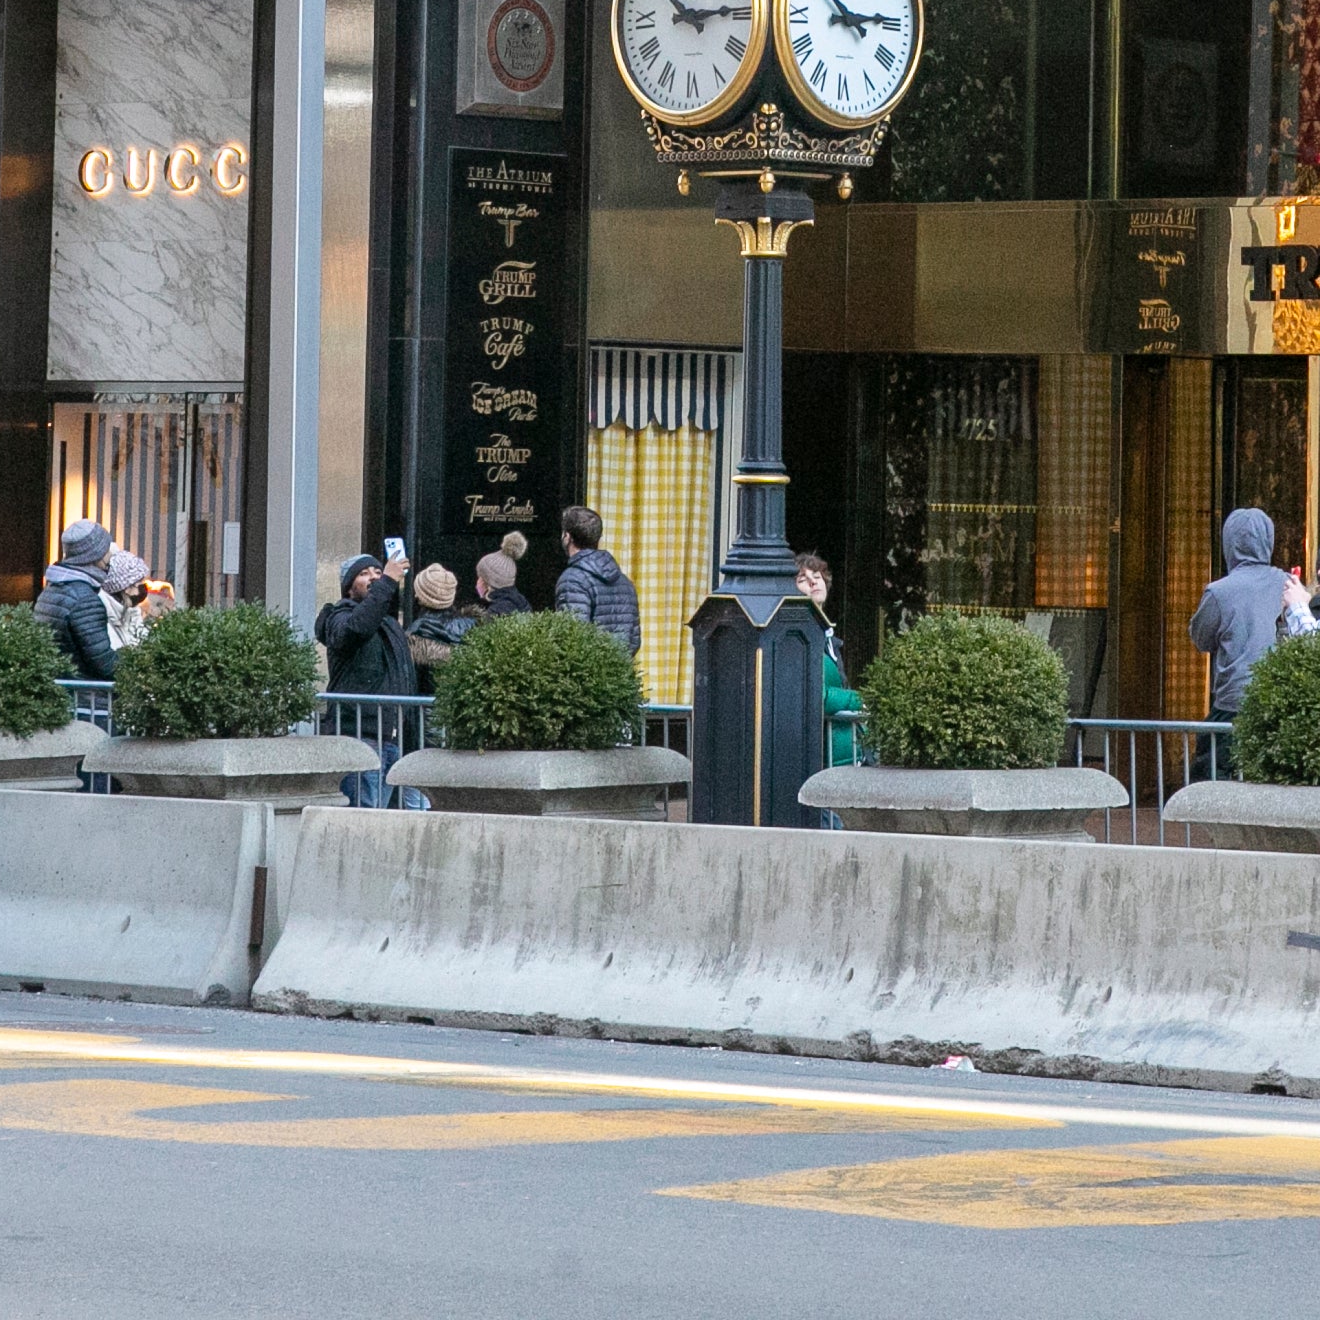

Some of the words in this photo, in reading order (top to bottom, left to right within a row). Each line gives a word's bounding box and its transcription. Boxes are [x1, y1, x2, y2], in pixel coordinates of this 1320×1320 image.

[467, 166, 493, 179] THE
[496, 160, 553, 184] ATRIUM
[478, 201, 515, 218] Trump
[516, 203, 539, 218] Bar
[478, 280, 537, 302] GRILL
[480, 317, 534, 336] TRUMP
[483, 331, 526, 370] Café
[472, 394, 492, 415] ICE
[494, 389, 538, 412] CREAM
[490, 433, 512, 448] The
[476, 447, 532, 464] TRUMP
[465, 494, 500, 523] Trump
